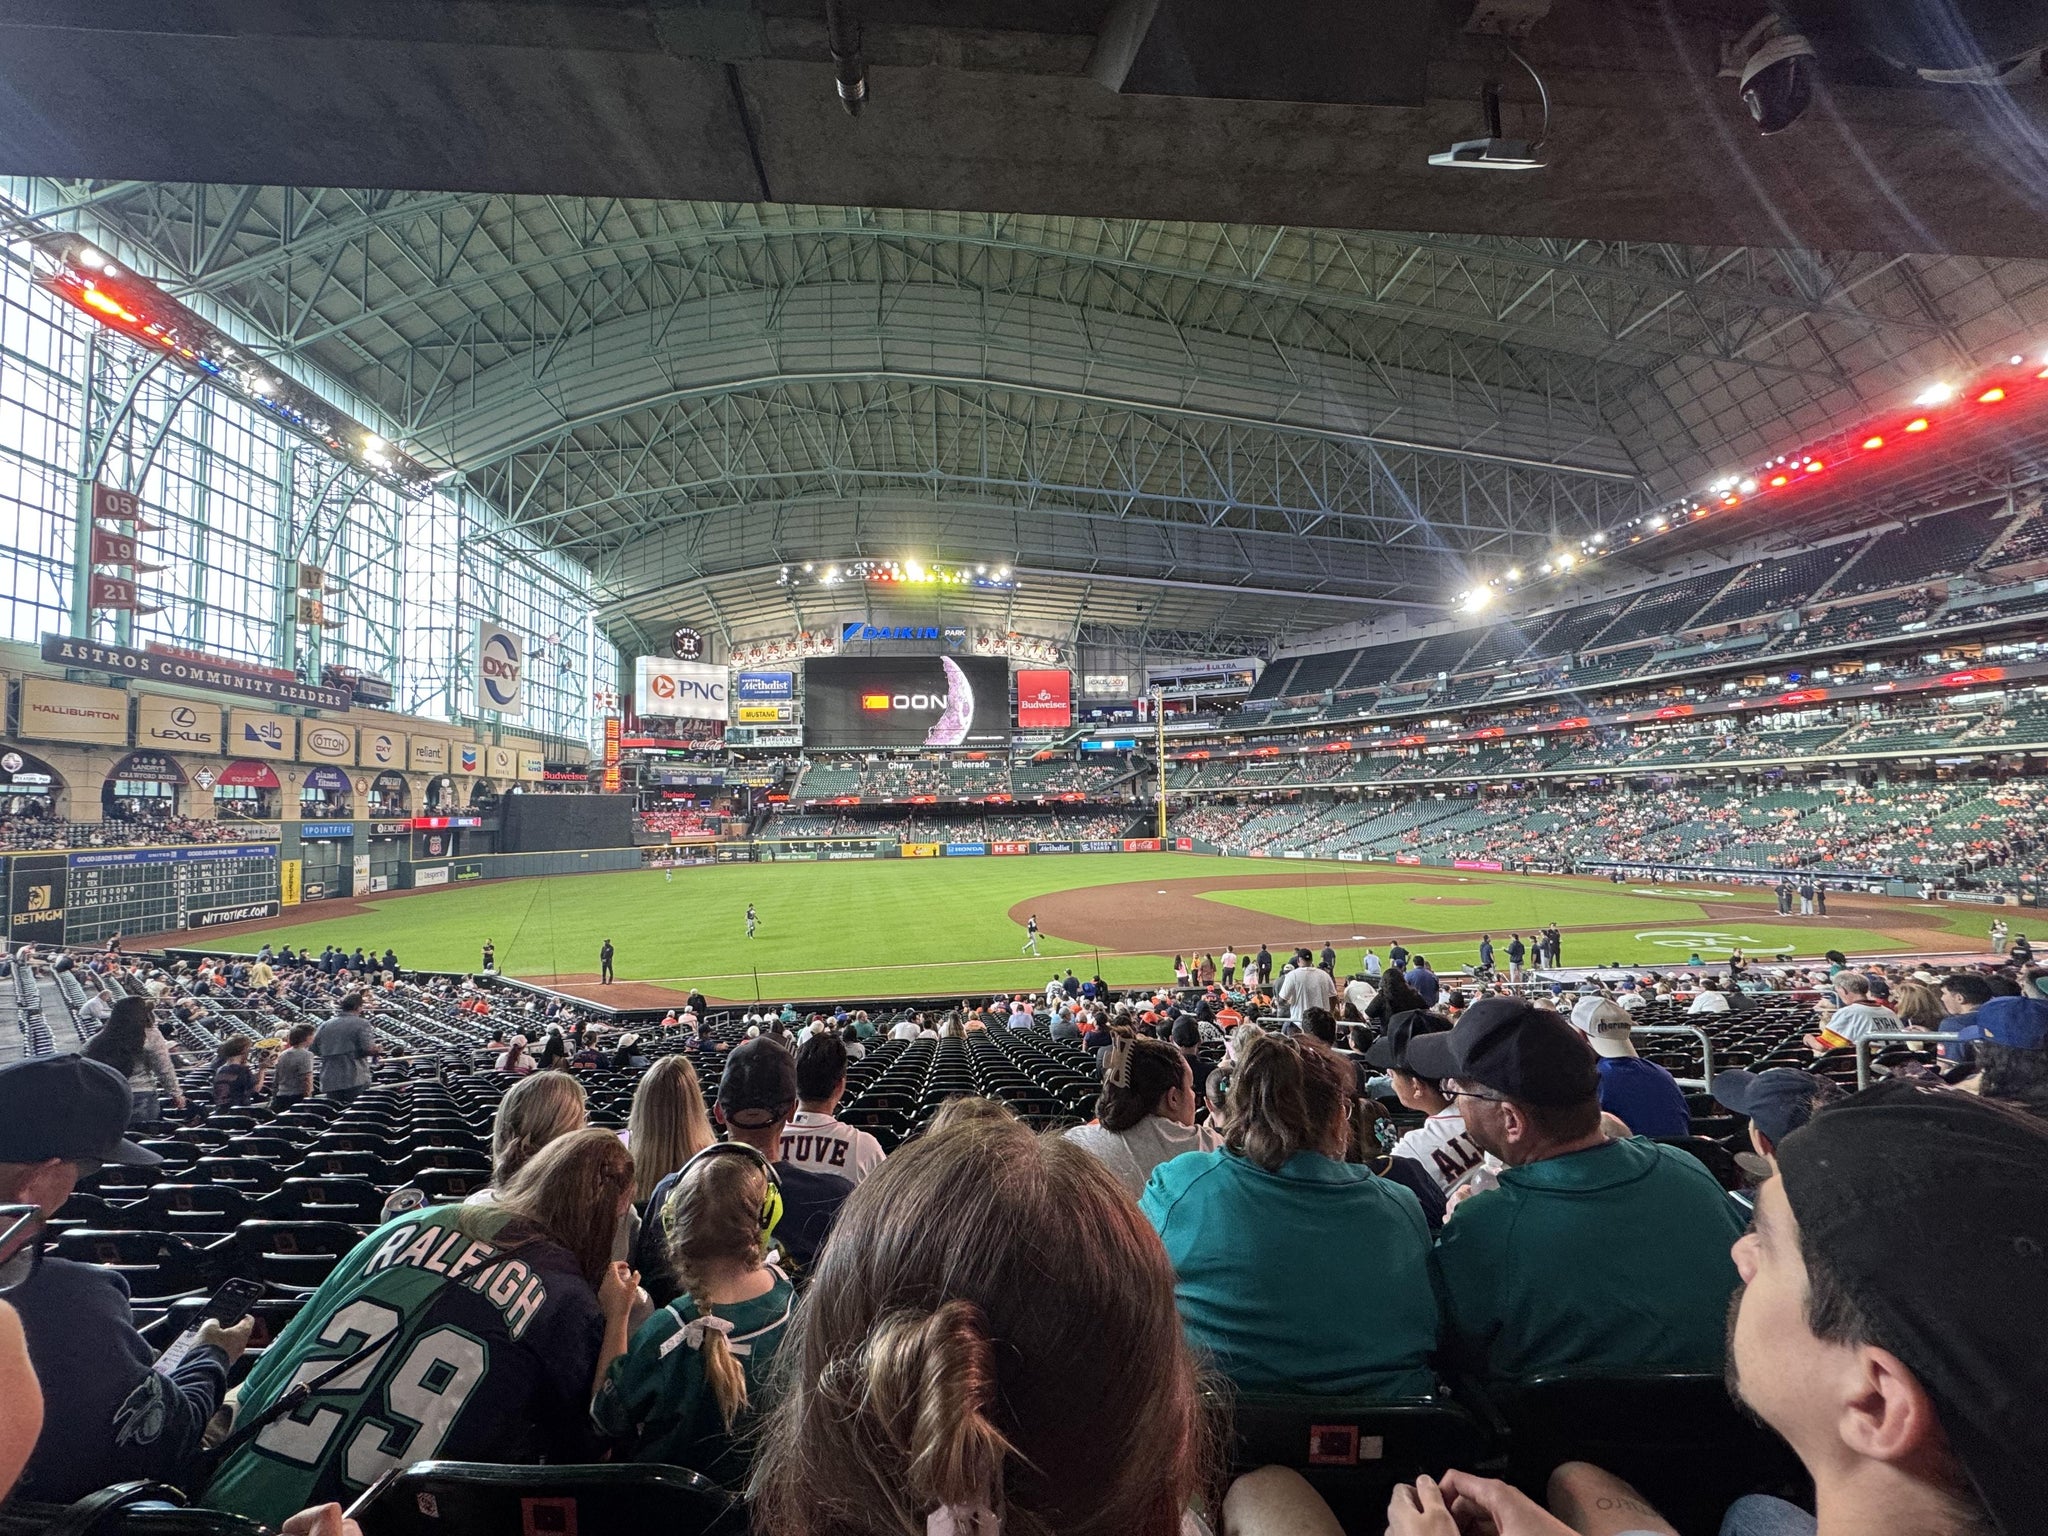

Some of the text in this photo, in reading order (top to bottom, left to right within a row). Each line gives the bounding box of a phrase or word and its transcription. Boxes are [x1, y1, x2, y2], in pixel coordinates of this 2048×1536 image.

[106, 494, 132, 514] 05
[106, 542, 131, 559] 19
[306, 571, 321, 584] 17
[104, 585, 128, 600] 21
[676, 628, 700, 640] HOUSTON
[862, 626, 938, 639] DAIKIN
[995, 640, 1006, 648] 24
[677, 650, 699, 659] ASTROS
[749, 649, 761, 657] 40
[60, 643, 150, 670] ASTROS
[160, 662, 273, 693] COMMUNITY
[280, 685, 341, 706] LEADERS
[482, 656, 519, 682] OXY
[678, 680, 724, 701] PNC
[742, 680, 788, 690] Methodist
[32, 704, 120, 720] HALLIBURTON
[151, 728, 211, 742] LEXUS
[260, 722, 282, 739] slb
[416, 746, 441, 758] reliant
[689, 740, 722, 750] Coca-Cola
[316, 771, 337, 780] planet
[543, 772, 588, 780] Budweiser
[318, 779, 341, 787] fitness
[13, 910, 63, 926] BETMGM
[202, 905, 268, 925] NITTOTIRE.COM
[1872, 1017, 1899, 1031] RYAN
[363, 1222, 546, 1340] RALEIGH
[256, 1300, 488, 1489] 29
